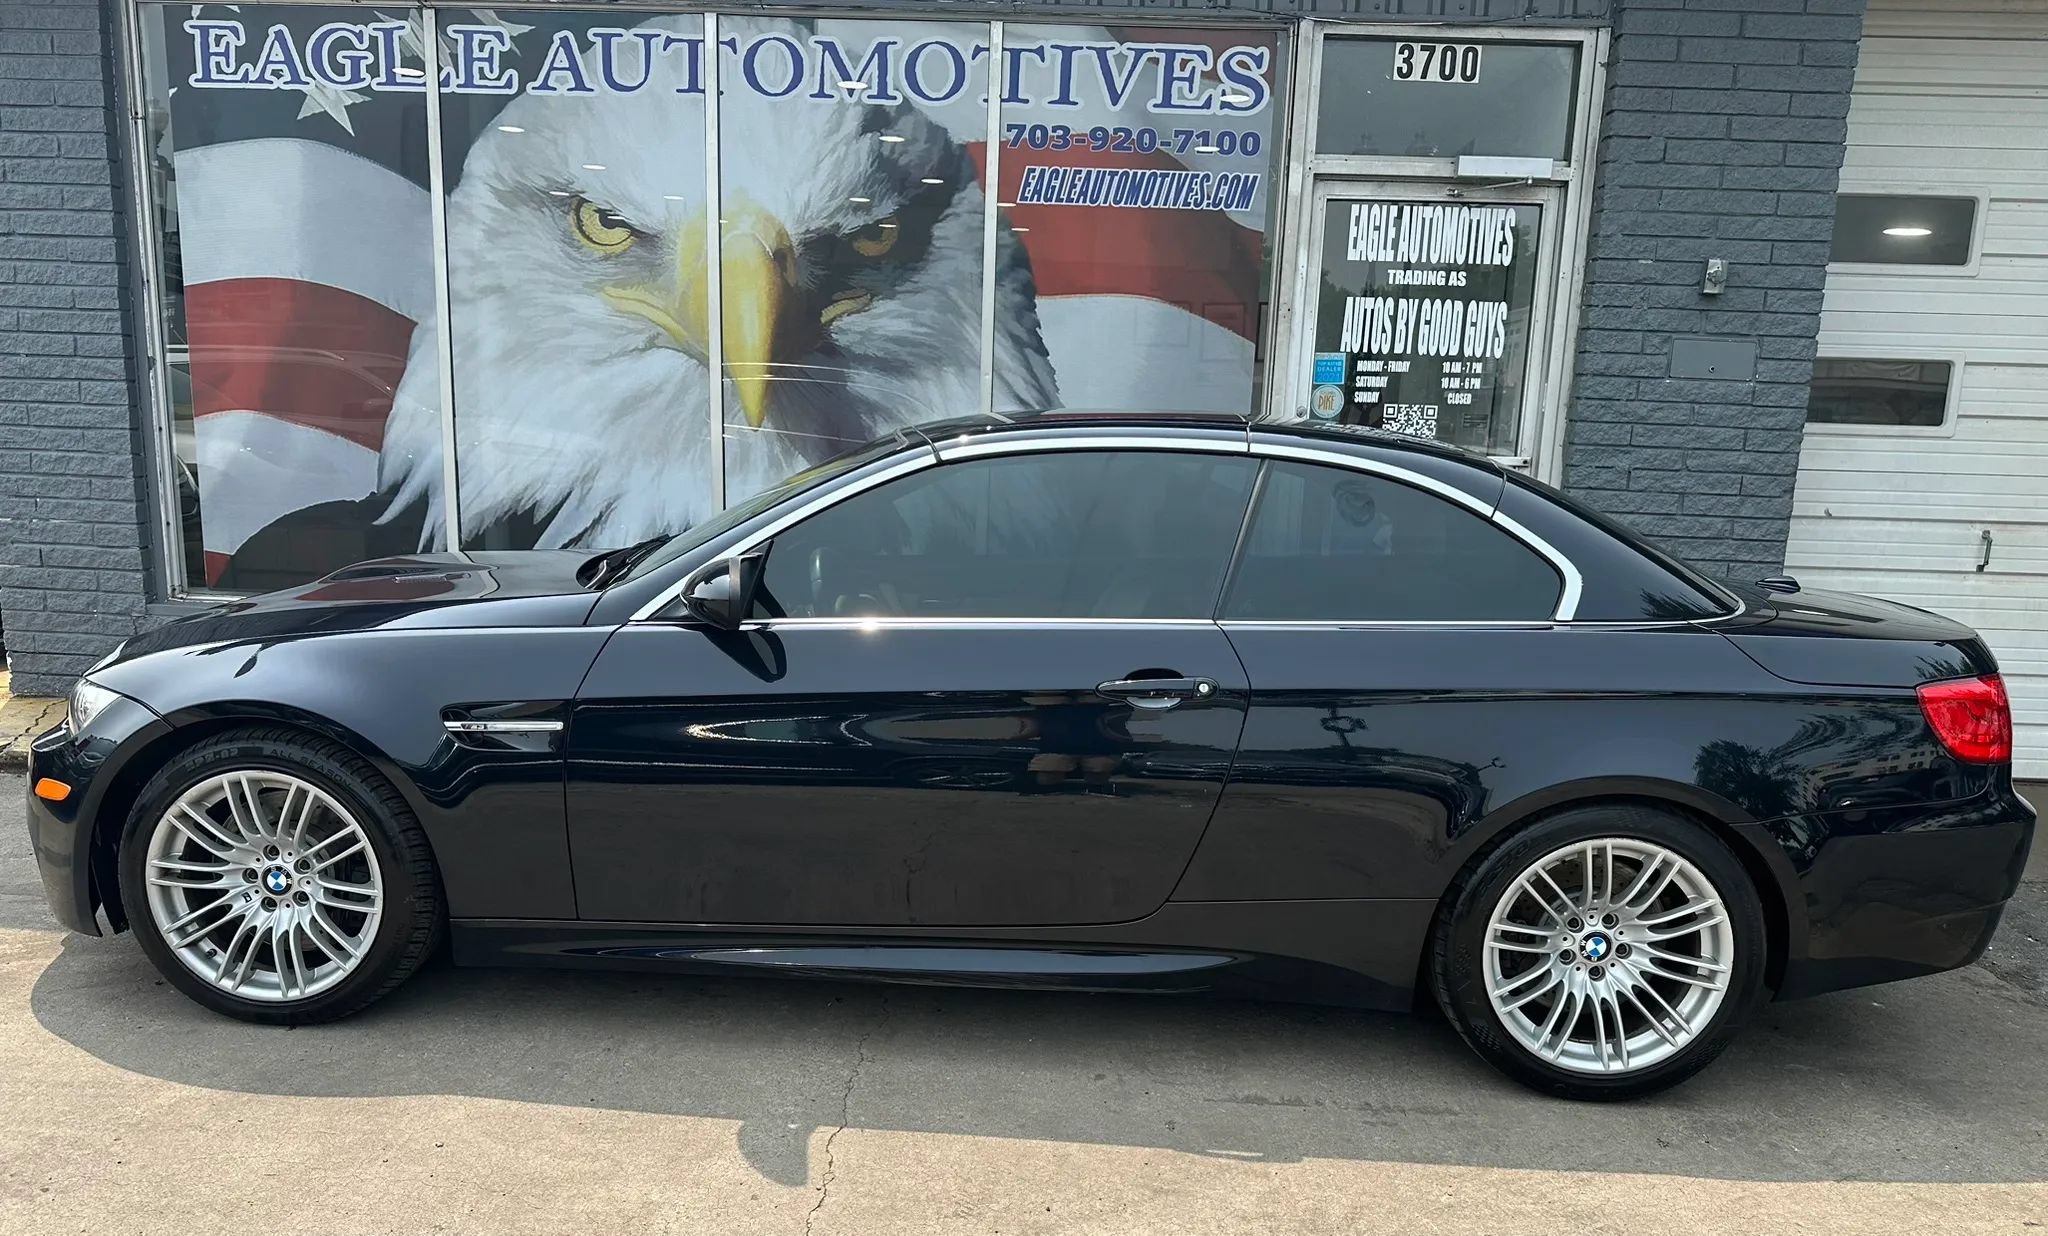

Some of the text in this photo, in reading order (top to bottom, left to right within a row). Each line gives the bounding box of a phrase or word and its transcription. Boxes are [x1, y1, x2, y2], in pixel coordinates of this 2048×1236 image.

[186, 22, 1270, 114] EAGLE AUTOMOTIVES
[1396, 43, 1479, 82] 3700
[1005, 123, 1262, 156] 703-920-7100
[1017, 166, 1260, 211] EAGLEAUTOMOTIVES.COM
[1347, 203, 1516, 266] EAGLE AUTOMOTIVES
[1388, 269, 1466, 287] TRADING AS
[1340, 297, 1507, 359] AUTOS BY GOOD GUYS
[1356, 361, 1384, 372] MONDAY
[1388, 361, 1410, 373] FRIDAY
[1442, 362, 1451, 373] 10
[1450, 362, 1462, 374] AM
[1466, 362, 1471, 373] 7
[1472, 362, 1483, 374] PM
[1355, 376, 1388, 388] SATURDAY
[1441, 378, 1449, 389] 10
[1449, 378, 1461, 389] AM
[1464, 378, 1470, 389] 6
[1470, 378, 1482, 389] PM
[1318, 393, 1336, 411] PIKE
[1354, 391, 1380, 403] SUNDAY
[1447, 393, 1472, 405] CLOSED
